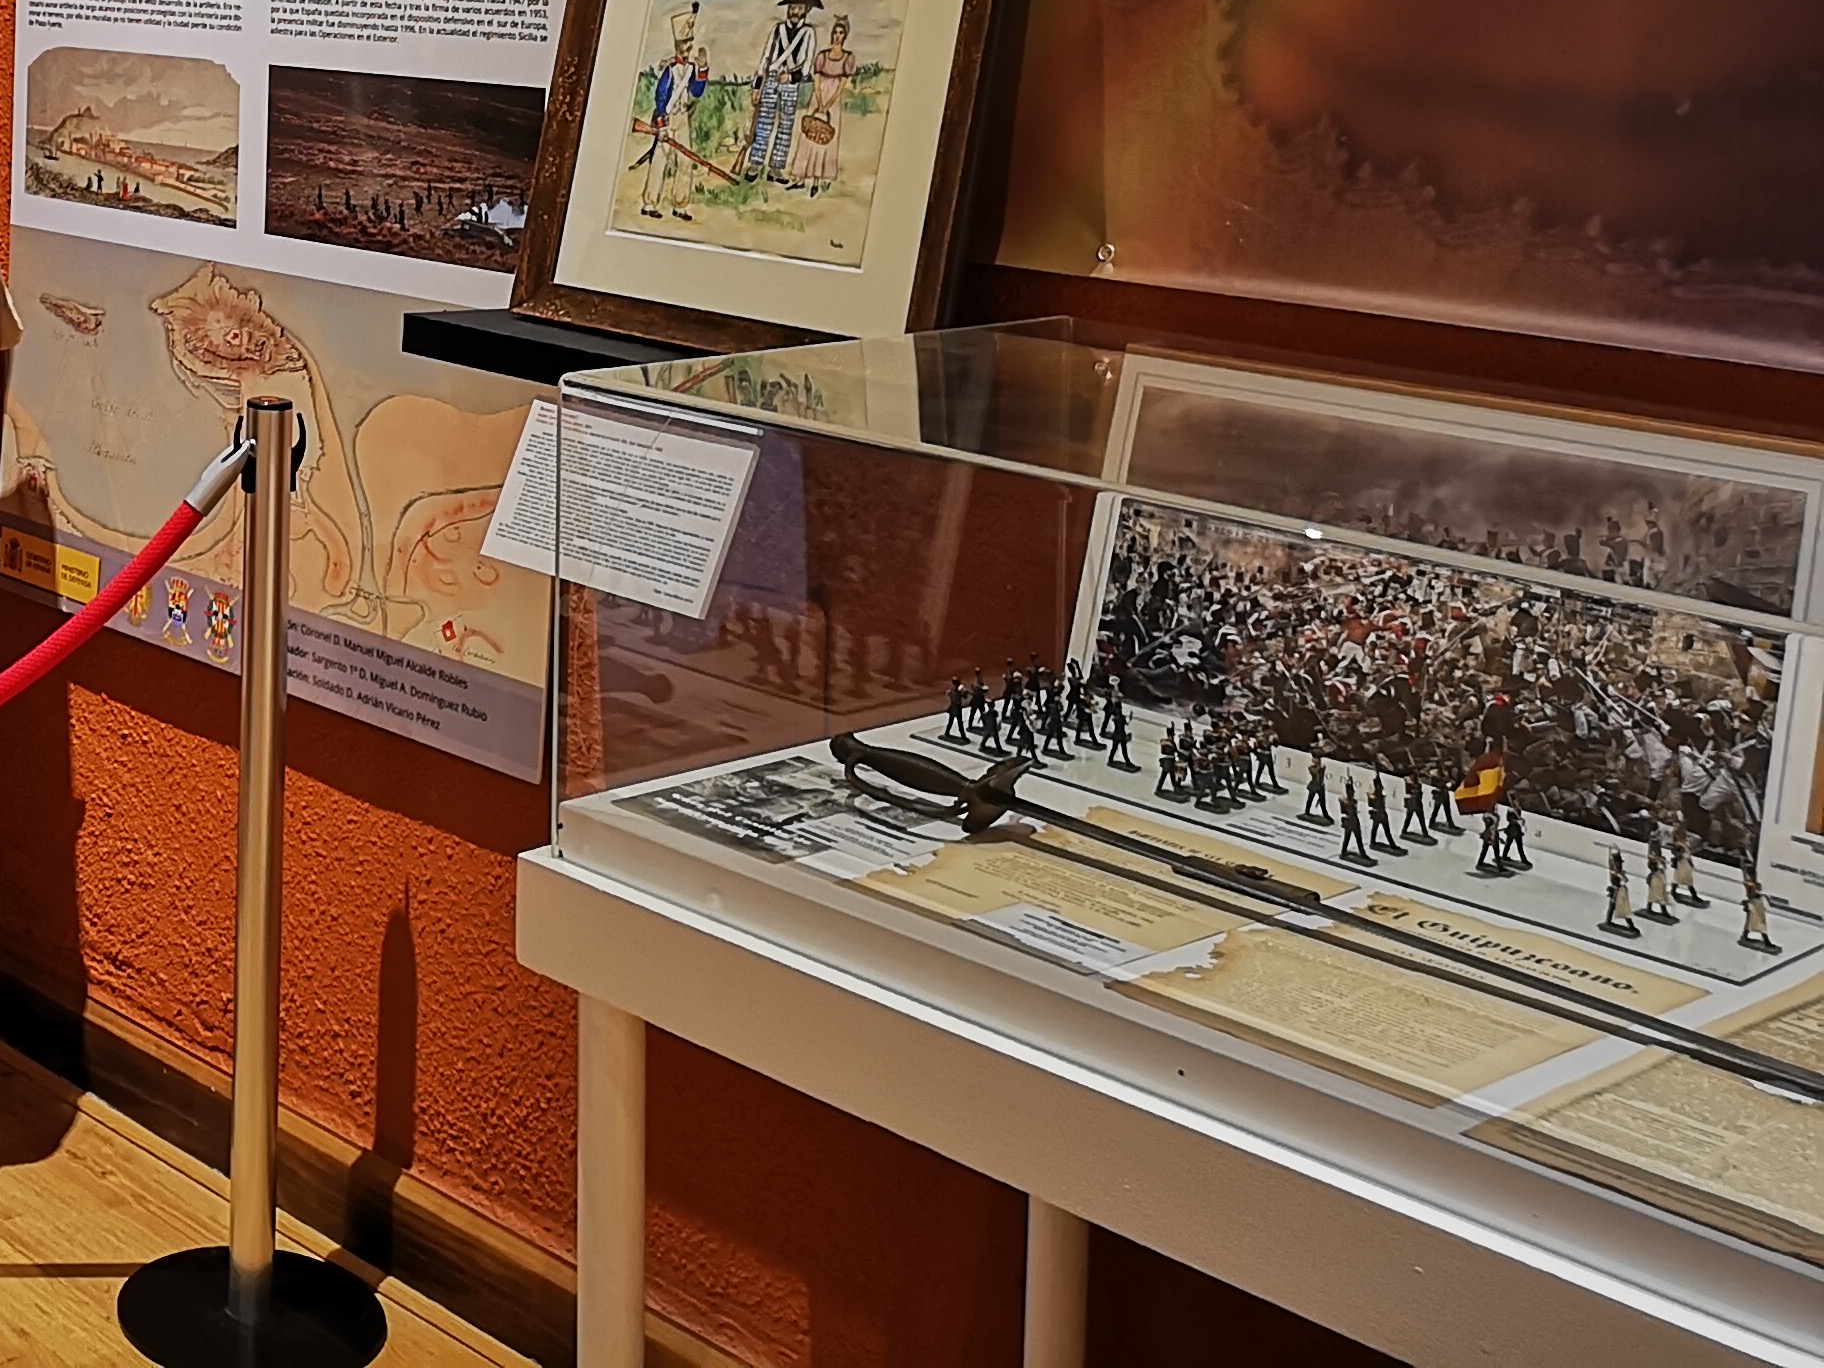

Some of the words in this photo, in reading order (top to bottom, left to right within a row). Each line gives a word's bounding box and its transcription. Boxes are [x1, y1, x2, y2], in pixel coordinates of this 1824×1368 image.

[300, 623, 332, 642] Coronel
[343, 638, 375, 657] Manuel
[376, 648, 405, 667] Miguel
[405, 659, 437, 678] Alcalde
[438, 669, 468, 689] Robles
[312, 652, 348, 672] Sargento
[370, 671, 399, 690] Miguel
[461, 702, 488, 721] Rubio
[312, 675, 344, 695] Soldado
[385, 701, 414, 720] Vicario
[1367, 904, 1410, 920] El
